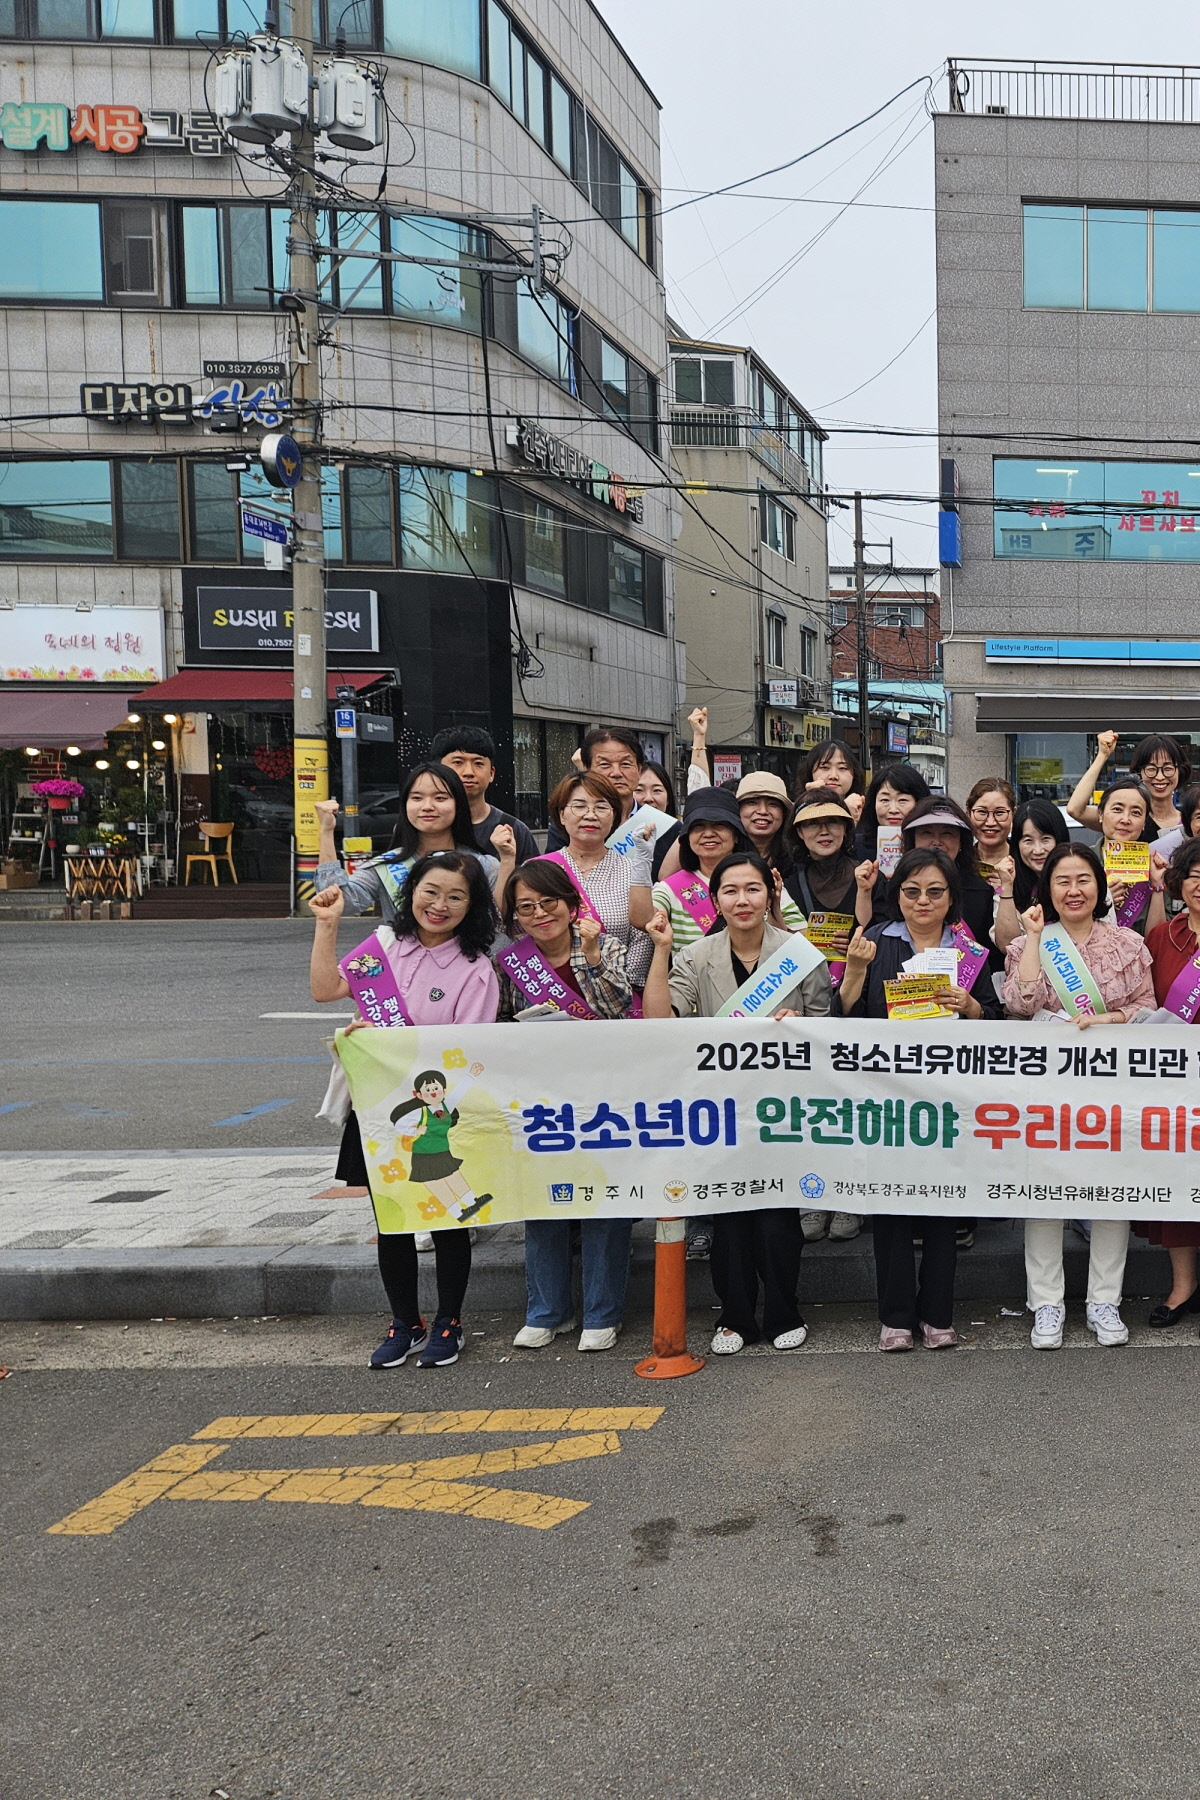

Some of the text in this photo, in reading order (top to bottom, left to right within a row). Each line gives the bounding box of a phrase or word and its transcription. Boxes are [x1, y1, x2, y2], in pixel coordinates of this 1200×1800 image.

[0, 105, 232, 156] 설계 시공 그룹
[206, 363, 280, 375] 010.3827.6958
[83, 386, 188, 422] 디자인
[213, 609, 361, 633] SUSHI FESH
[340, 711, 350, 720] 16
[1108, 842, 1122, 852] NO
[810, 914, 825, 924] NO
[503, 952, 542, 997] 건강한
[525, 954, 567, 999] 행복한
[1043, 937, 1083, 992] 청소년이
[741, 957, 799, 1013] 청소년이
[697, 1041, 812, 1072] 2025년
[830, 1041, 1048, 1077] 청소년유해환경
[1057, 1045, 1118, 1078] 개선
[1128, 1047, 1189, 1079] 민관
[522, 1098, 738, 1154] 청소년이
[755, 1096, 960, 1150] 안전해야
[972, 1102, 1122, 1153] 우리의
[577, 1184, 645, 1202] 경주시
[693, 1178, 785, 1200] 경주경찰서
[833, 1179, 968, 1200] 경상북도경주교육지원청
[986, 1182, 1172, 1205] 경주시청년유해환경감시단
